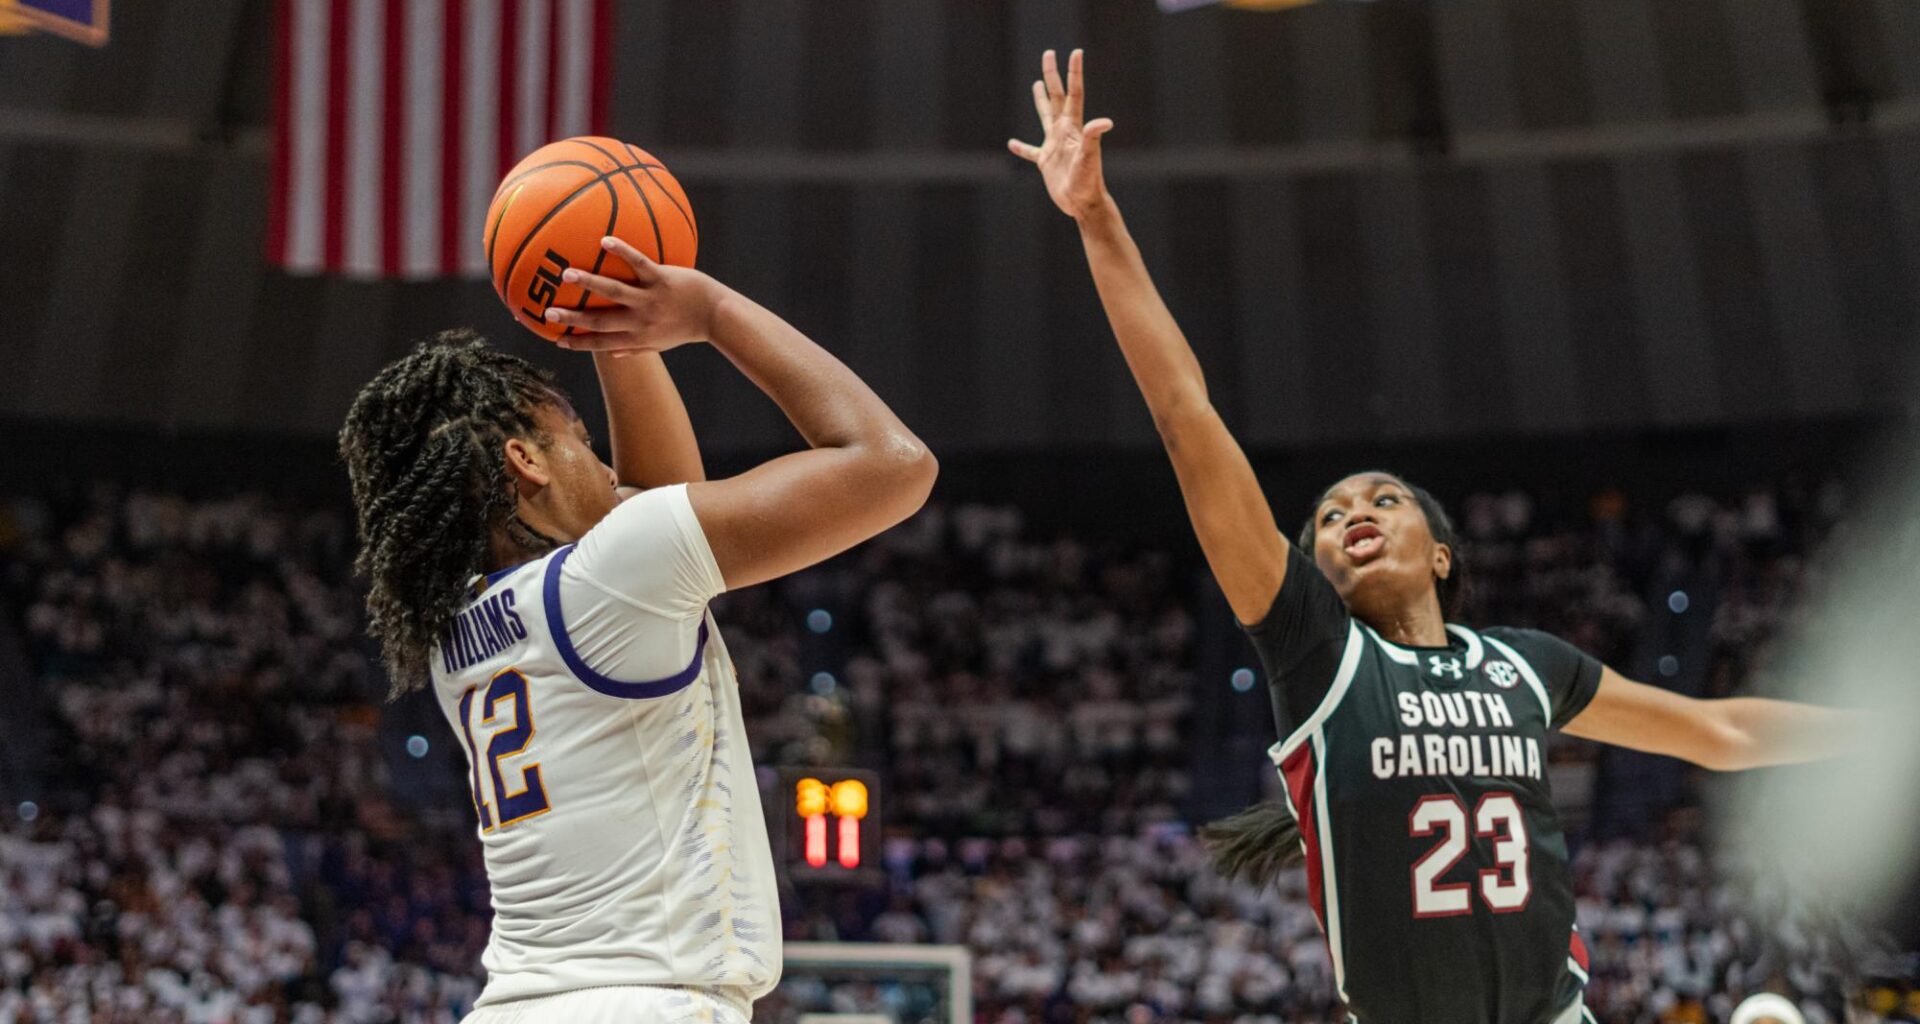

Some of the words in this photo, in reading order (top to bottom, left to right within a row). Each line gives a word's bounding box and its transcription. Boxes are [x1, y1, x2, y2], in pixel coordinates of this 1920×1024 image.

[522, 248, 570, 325] LSU
[439, 587, 528, 674] WILLIAMS
[1398, 690, 1513, 727] SOUTH
[1484, 660, 1519, 689] SEC
[459, 667, 552, 833] 12
[1371, 734, 1541, 780] CAROLINA
[1408, 791, 1532, 919] 23
